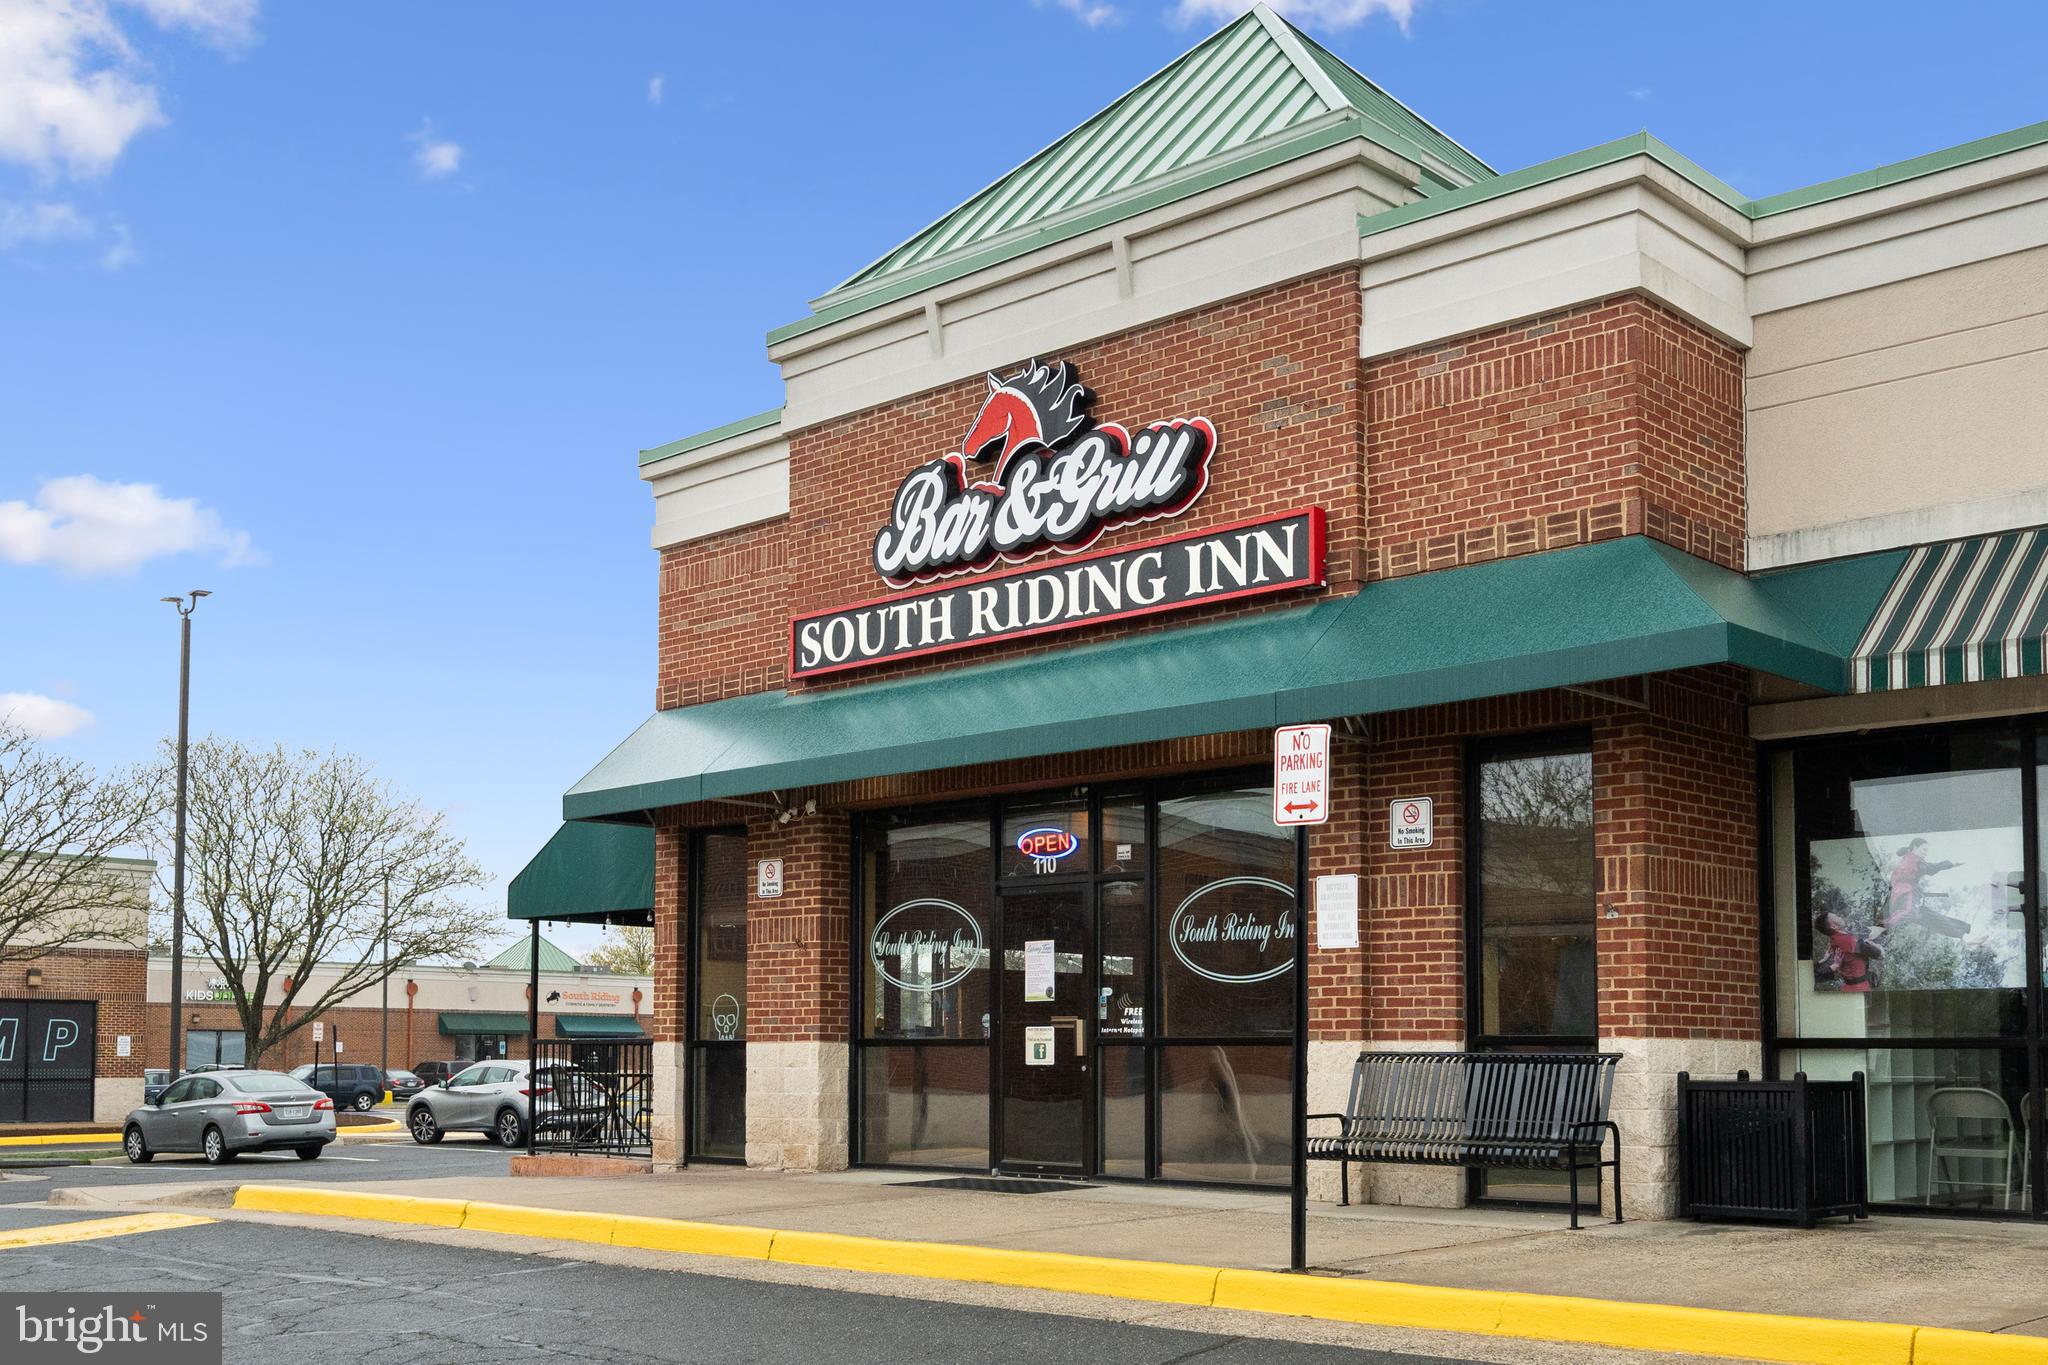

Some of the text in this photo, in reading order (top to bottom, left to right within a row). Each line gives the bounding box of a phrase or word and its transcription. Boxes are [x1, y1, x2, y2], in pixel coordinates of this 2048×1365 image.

[878, 432, 1190, 571] Bar & Grill
[800, 524, 1299, 668] SOUTH RIDING INN
[1292, 733, 1311, 751] NO
[1280, 752, 1323, 772] PARKING
[1281, 780, 1321, 795] FIRE LANE
[1021, 832, 1070, 855] OPEN
[1033, 857, 1057, 875] 110
[1180, 914, 1218, 943] South
[1221, 912, 1272, 953] Riding
[1274, 910, 1295, 940] In
[876, 932, 908, 956] South
[911, 930, 949, 966] Riding
[562, 991, 621, 1004] South Riding
[1124, 1007, 1144, 1016] FREE
